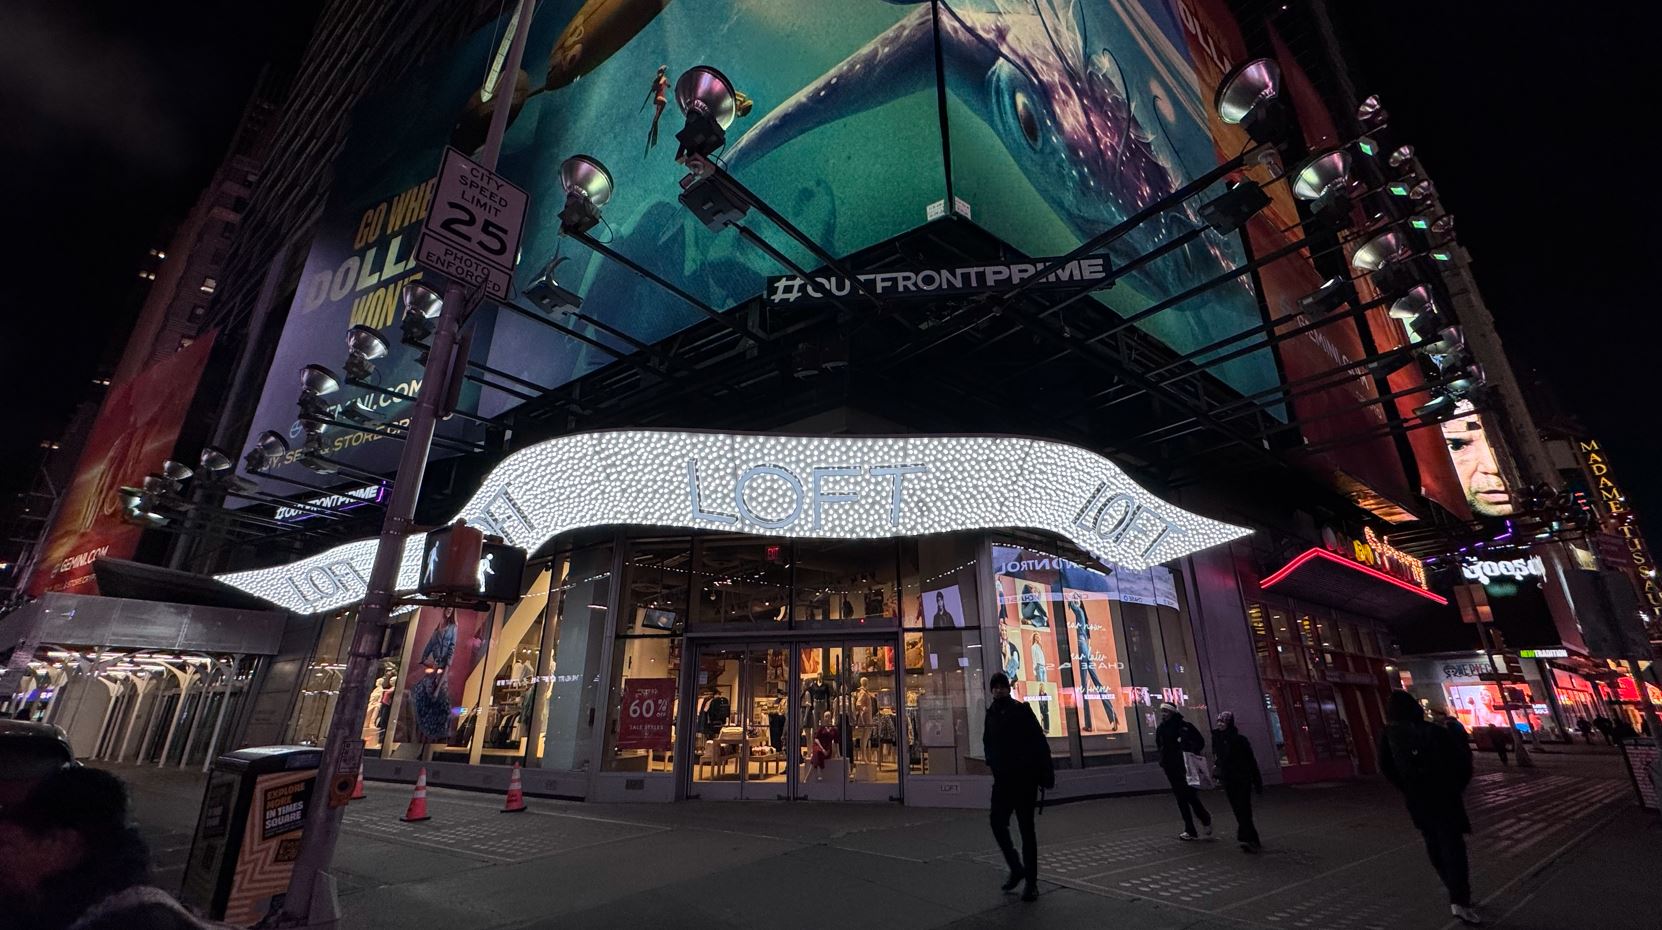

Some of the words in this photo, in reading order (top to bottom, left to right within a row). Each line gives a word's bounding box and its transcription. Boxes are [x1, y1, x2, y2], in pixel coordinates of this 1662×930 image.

[459, 174, 508, 208] SPEED
[470, 167, 504, 191] CITY
[353, 201, 388, 251] GO
[386, 176, 437, 236] WHE
[461, 190, 502, 217] LIMIT
[440, 201, 509, 256] 25
[300, 235, 417, 315] DOLL
[443, 248, 490, 276] PHOTO
[687, 458, 927, 531] LOFT
[1580, 439, 1625, 513] MADAME
[1070, 480, 1188, 558] LOFT
[285, 559, 368, 606] LOFT
[1617, 524, 1662, 617] TUSSAU
[266, 782, 305, 801] EXPLORE
[266, 808, 277, 820] IN
[277, 801, 305, 817] TIMES
[265, 810, 302, 829] SQUARE
